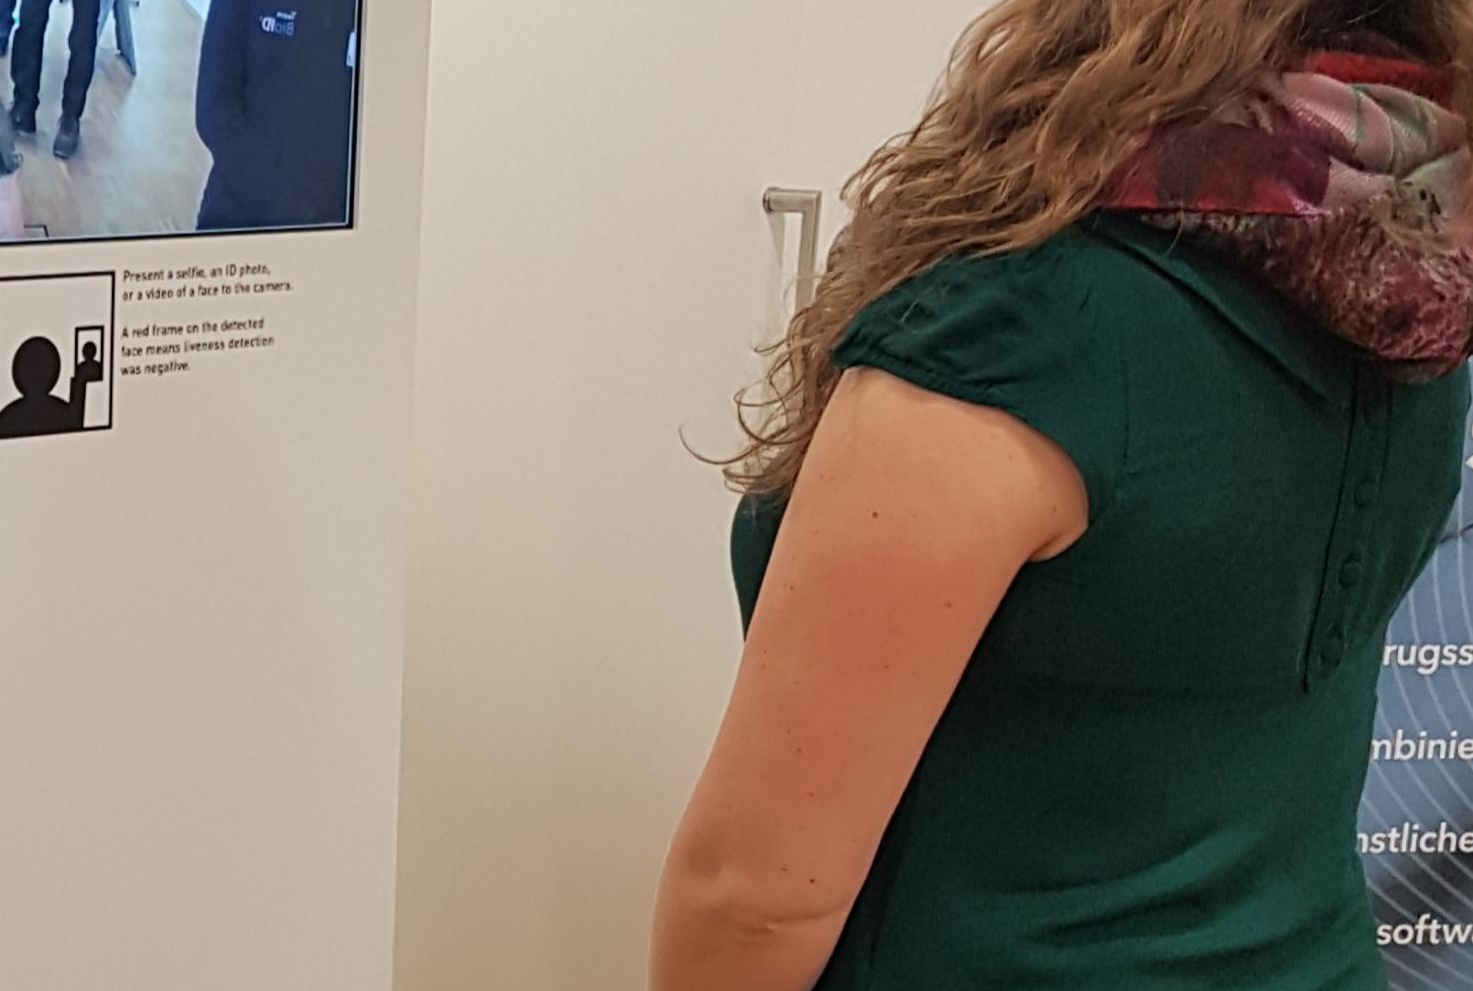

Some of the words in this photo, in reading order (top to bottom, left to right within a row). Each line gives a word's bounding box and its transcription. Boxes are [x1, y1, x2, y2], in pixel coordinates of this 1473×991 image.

[123, 270, 164, 282] Present
[167, 271, 173, 279] a
[176, 267, 207, 279] selfie,
[210, 268, 223, 278] an
[226, 264, 237, 276] ID
[239, 264, 270, 278] photo,
[122, 290, 133, 301] or
[137, 291, 143, 300] a
[146, 287, 173, 300] video
[176, 285, 186, 298] of
[189, 288, 195, 297] a
[197, 284, 218, 297] face
[221, 283, 232, 295] to
[234, 282, 250, 294] the
[253, 282, 294, 293] camera.
[121, 327, 128, 338] A
[132, 325, 149, 337] red
[152, 324, 183, 336] frame
[186, 323, 199, 334] on
[202, 321, 218, 333] the
[220, 318, 264, 331] detected
[121, 345, 143, 357] face
[146, 343, 180, 356] means
[183, 339, 225, 353] liveness
[228, 336, 275, 350] detection
[121, 365, 142, 376] was
[144, 360, 190, 376] negative.
[1377, 913, 1473, 946] softw
